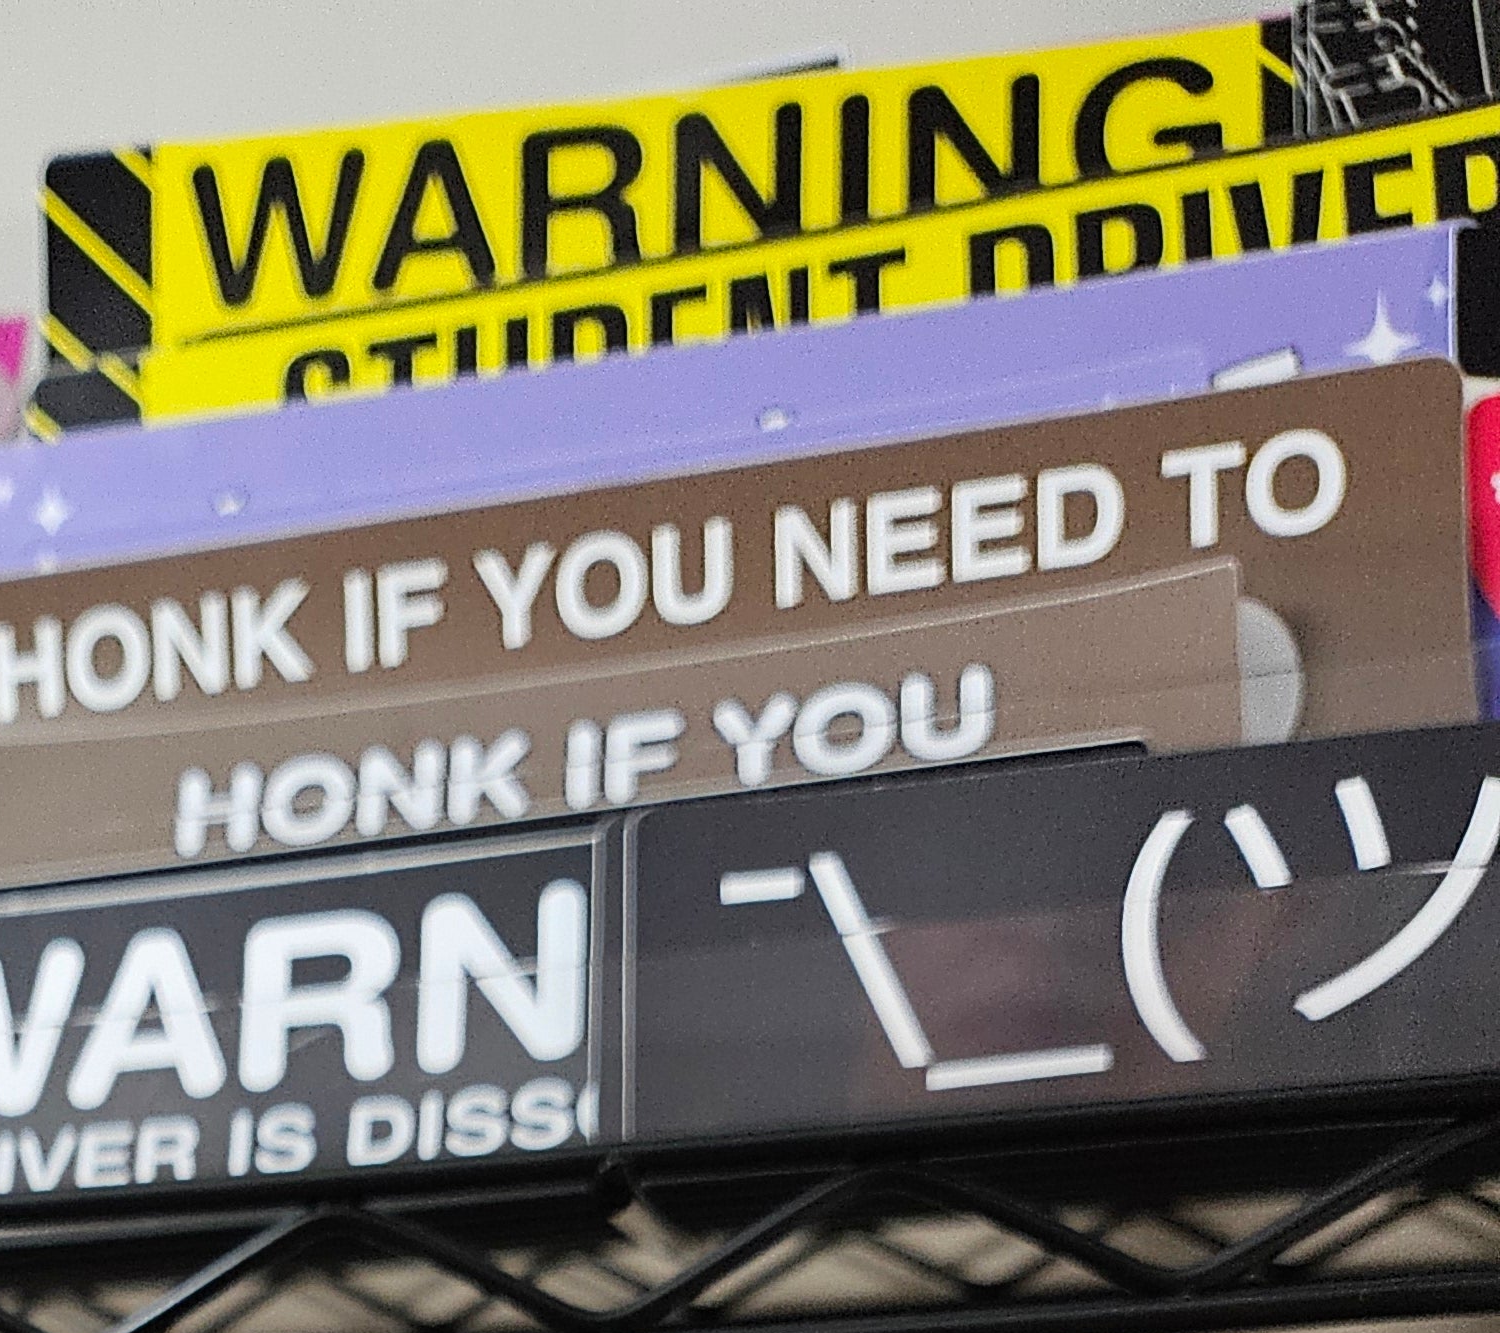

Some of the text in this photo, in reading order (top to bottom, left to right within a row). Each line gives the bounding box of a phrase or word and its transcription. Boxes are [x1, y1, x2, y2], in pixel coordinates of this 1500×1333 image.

[190, 56, 1224, 308] WARNING
[341, 556, 450, 675] IF
[471, 515, 735, 650] YOU
[772, 460, 1128, 611] NEED
[1160, 427, 1349, 550] TO
[174, 660, 999, 860] HONK IF YOU
[227, 1101, 320, 1178] IS
